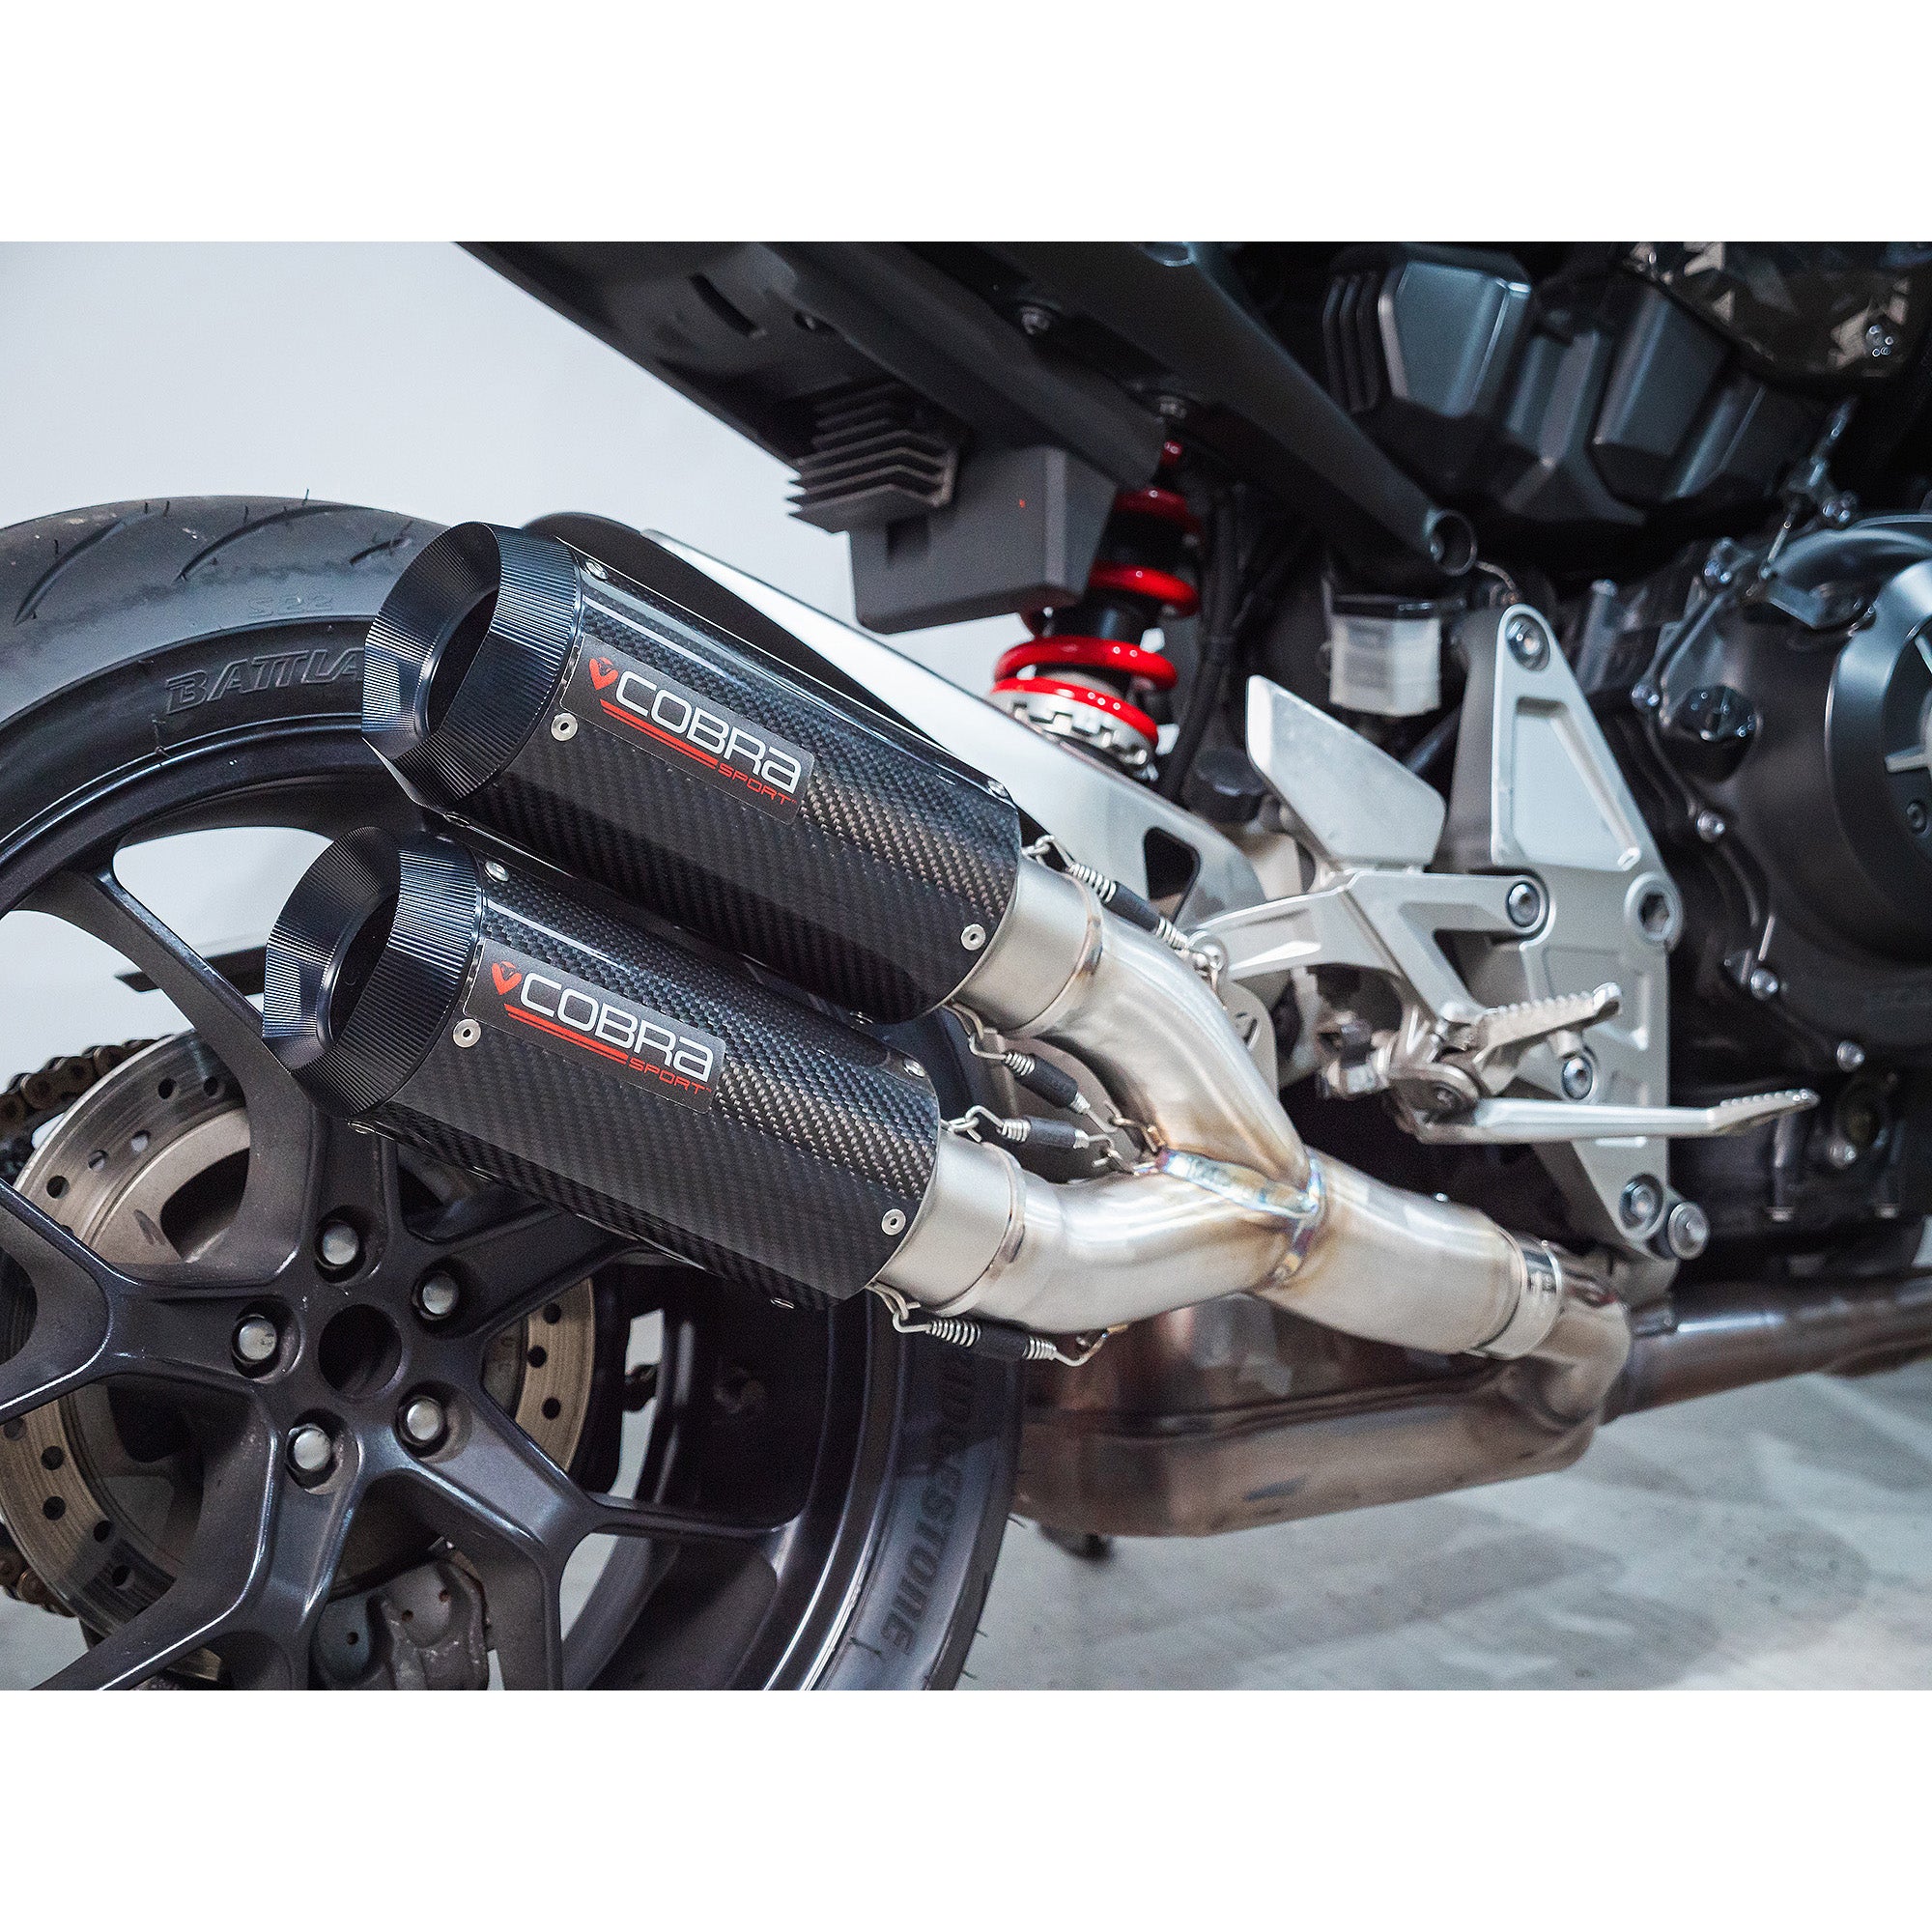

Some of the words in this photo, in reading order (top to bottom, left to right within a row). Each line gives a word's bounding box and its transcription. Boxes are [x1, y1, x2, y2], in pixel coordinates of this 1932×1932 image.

[164, 646, 366, 716] BATTLA
[615, 670, 802, 794] COBRA
[718, 762, 793, 805] SPORT
[520, 972, 714, 1082] COBRA
[629, 1057, 706, 1094] SPORT
